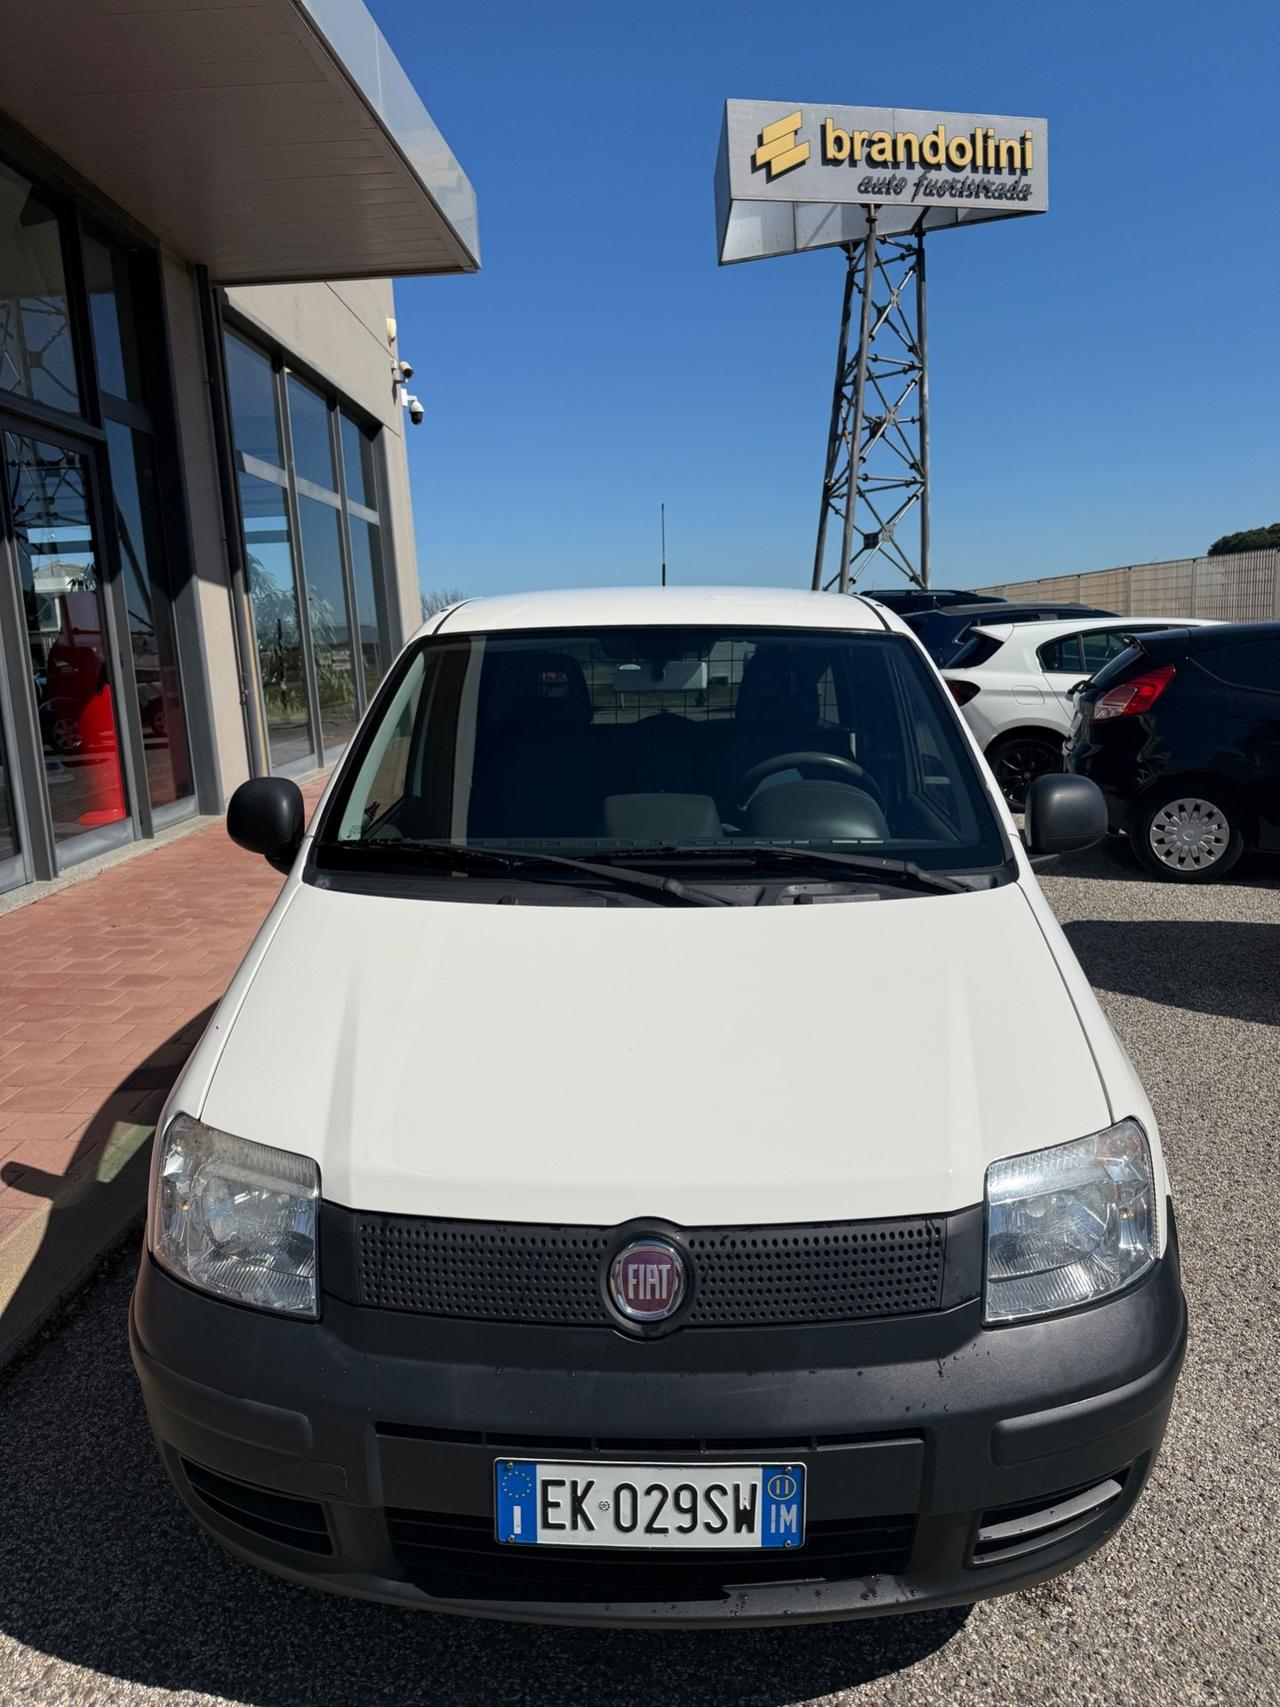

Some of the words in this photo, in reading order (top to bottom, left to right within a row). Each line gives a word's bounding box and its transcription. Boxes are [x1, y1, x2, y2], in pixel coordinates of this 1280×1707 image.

[824, 117, 1033, 171] brandolini
[858, 173, 907, 194] auto
[911, 169, 1032, 202] fuoristrada
[628, 1263, 671, 1300] FIAT
[513, 1505, 522, 1534] I
[540, 1478, 596, 1531] EK
[613, 1481, 758, 1534] 029SW
[770, 1504, 798, 1534] IM
